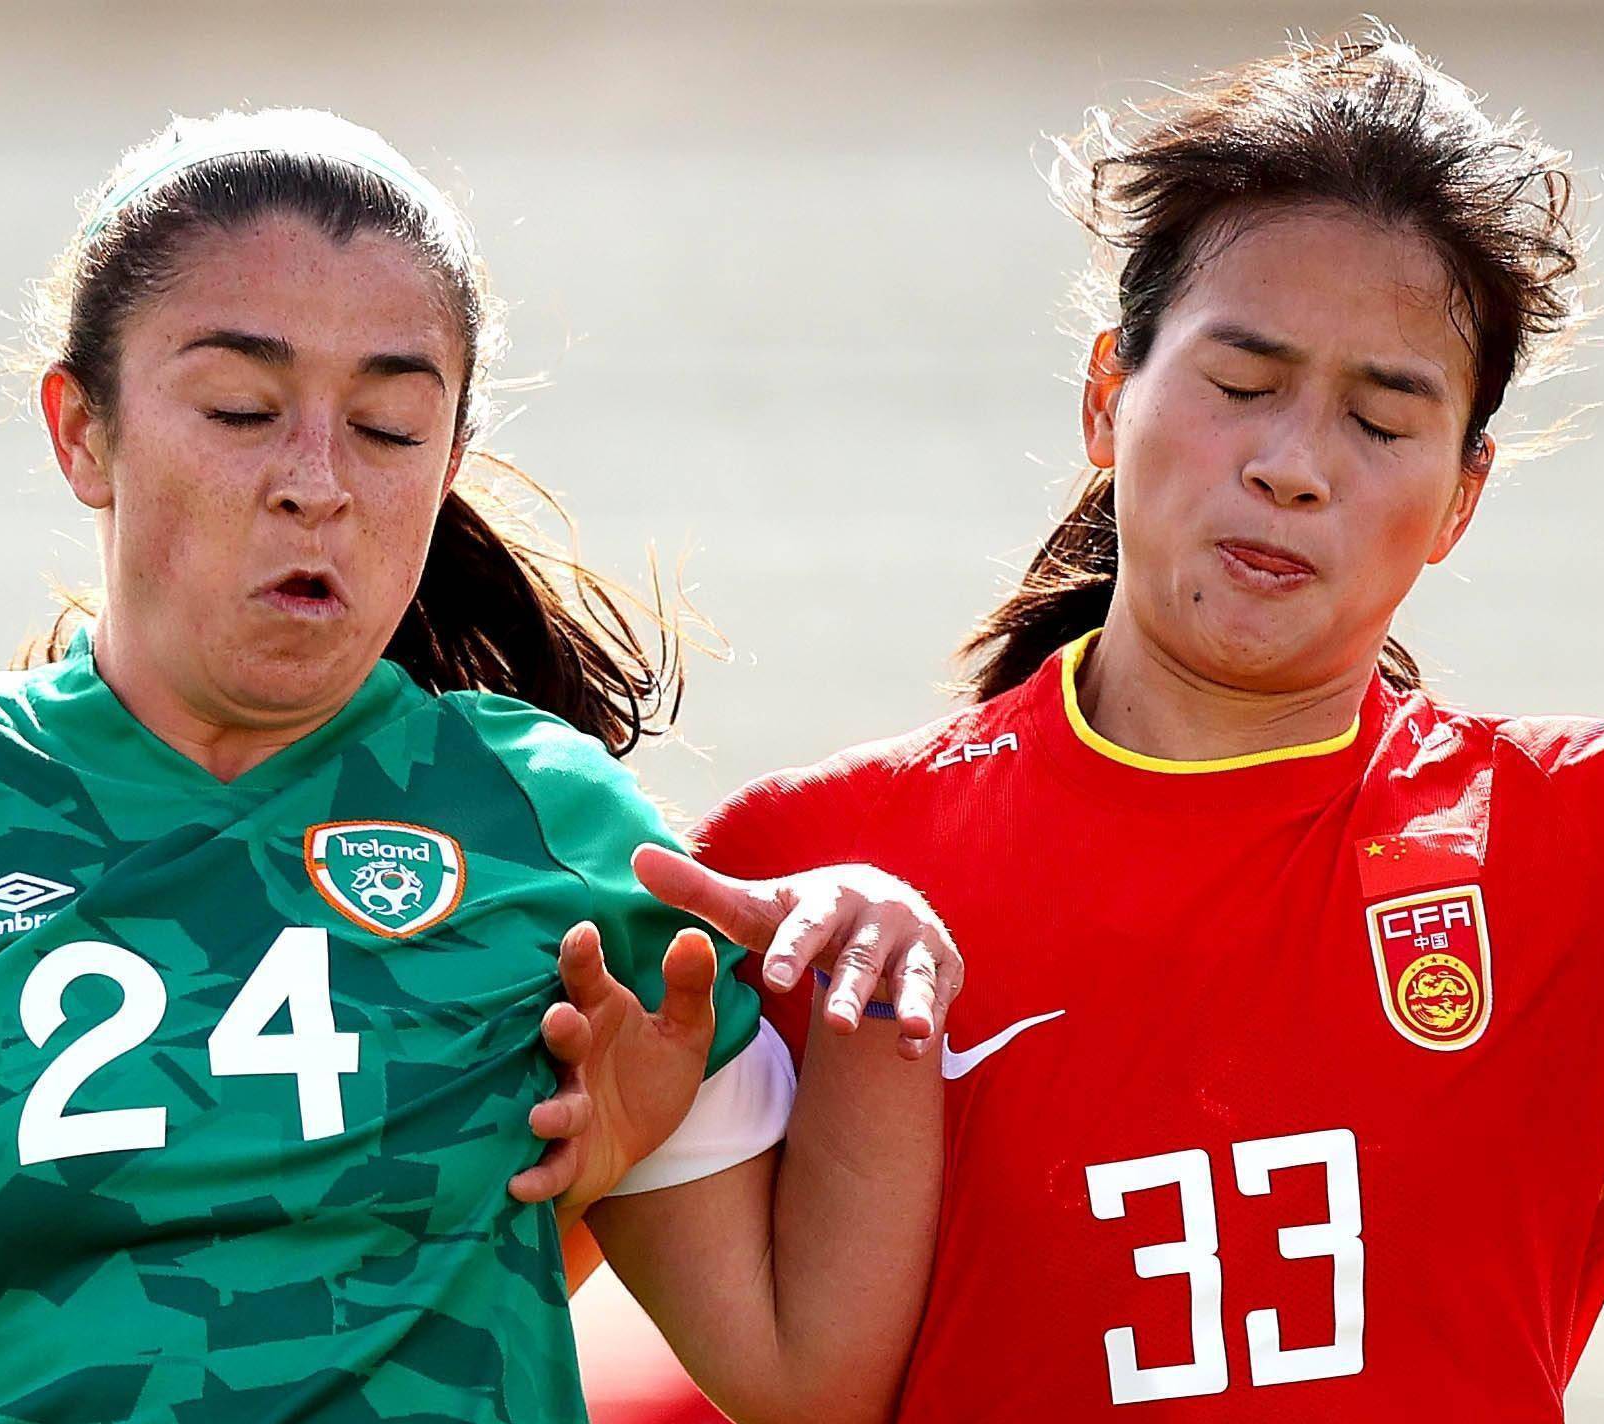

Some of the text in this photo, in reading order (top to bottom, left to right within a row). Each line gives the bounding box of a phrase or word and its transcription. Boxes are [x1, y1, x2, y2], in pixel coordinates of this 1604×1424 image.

[936, 732, 1018, 769] CFA
[336, 835, 430, 862] Ireland
[1382, 900, 1471, 939] CFA
[1414, 931, 1449, 951] 中国
[17, 926, 360, 1166] 24
[1085, 1128, 1365, 1405] 33
